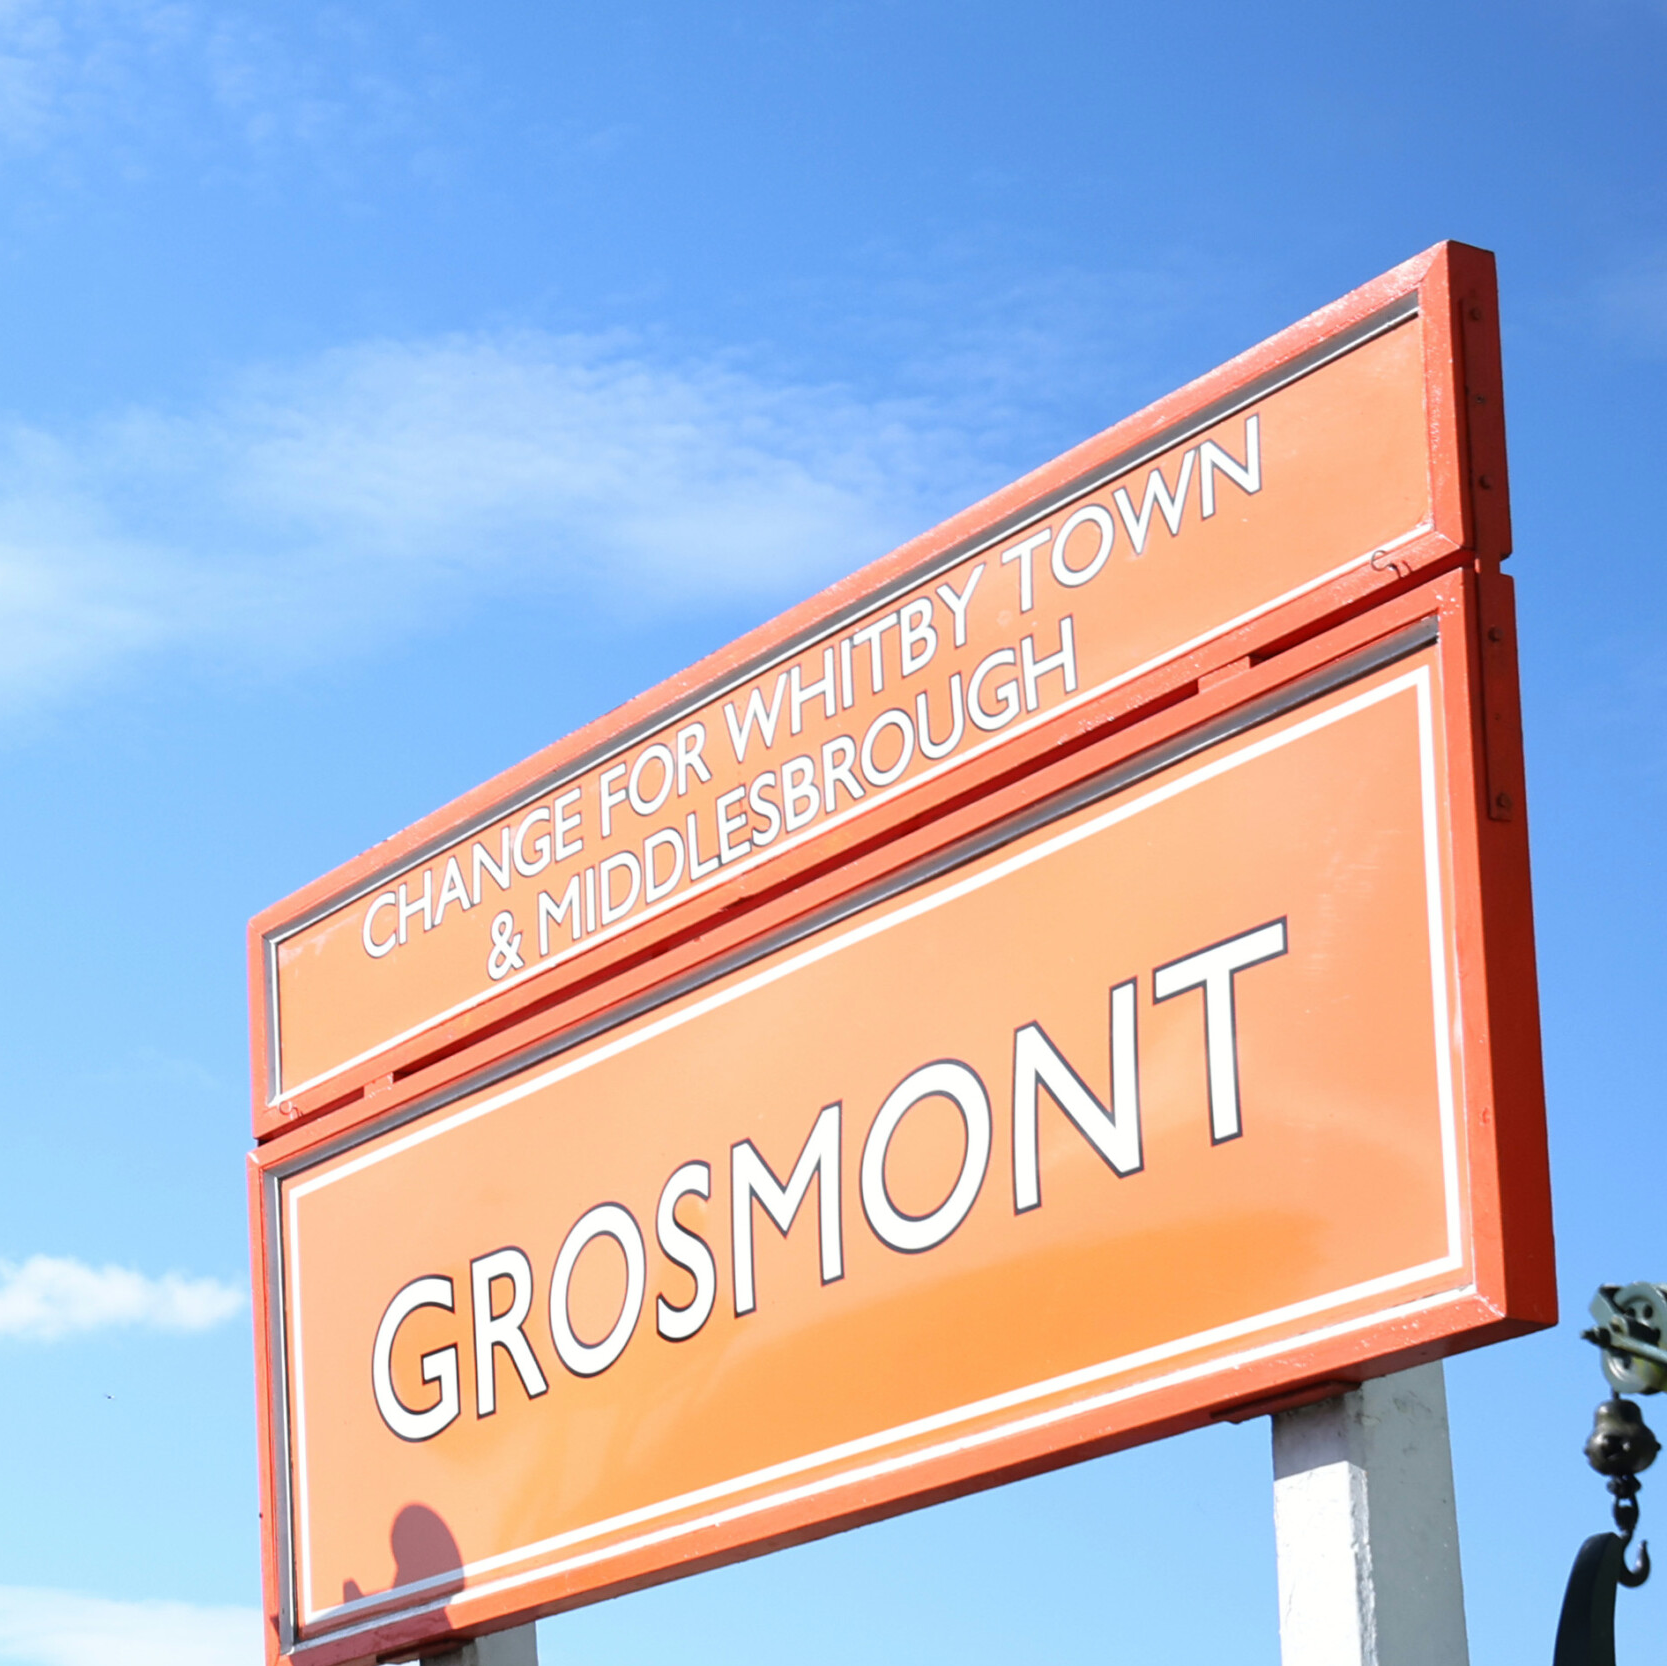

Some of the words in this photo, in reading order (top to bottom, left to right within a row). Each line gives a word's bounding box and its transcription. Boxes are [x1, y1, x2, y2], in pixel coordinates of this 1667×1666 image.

[361, 807, 583, 959] CHANGE
[599, 722, 709, 837] FOR
[722, 562, 986, 764] WHITBY
[1001, 412, 1263, 612] TOWN
[485, 912, 524, 982] &
[536, 613, 1080, 958] MIDDLESBROUGH
[370, 915, 1289, 1443] GROSMONT
